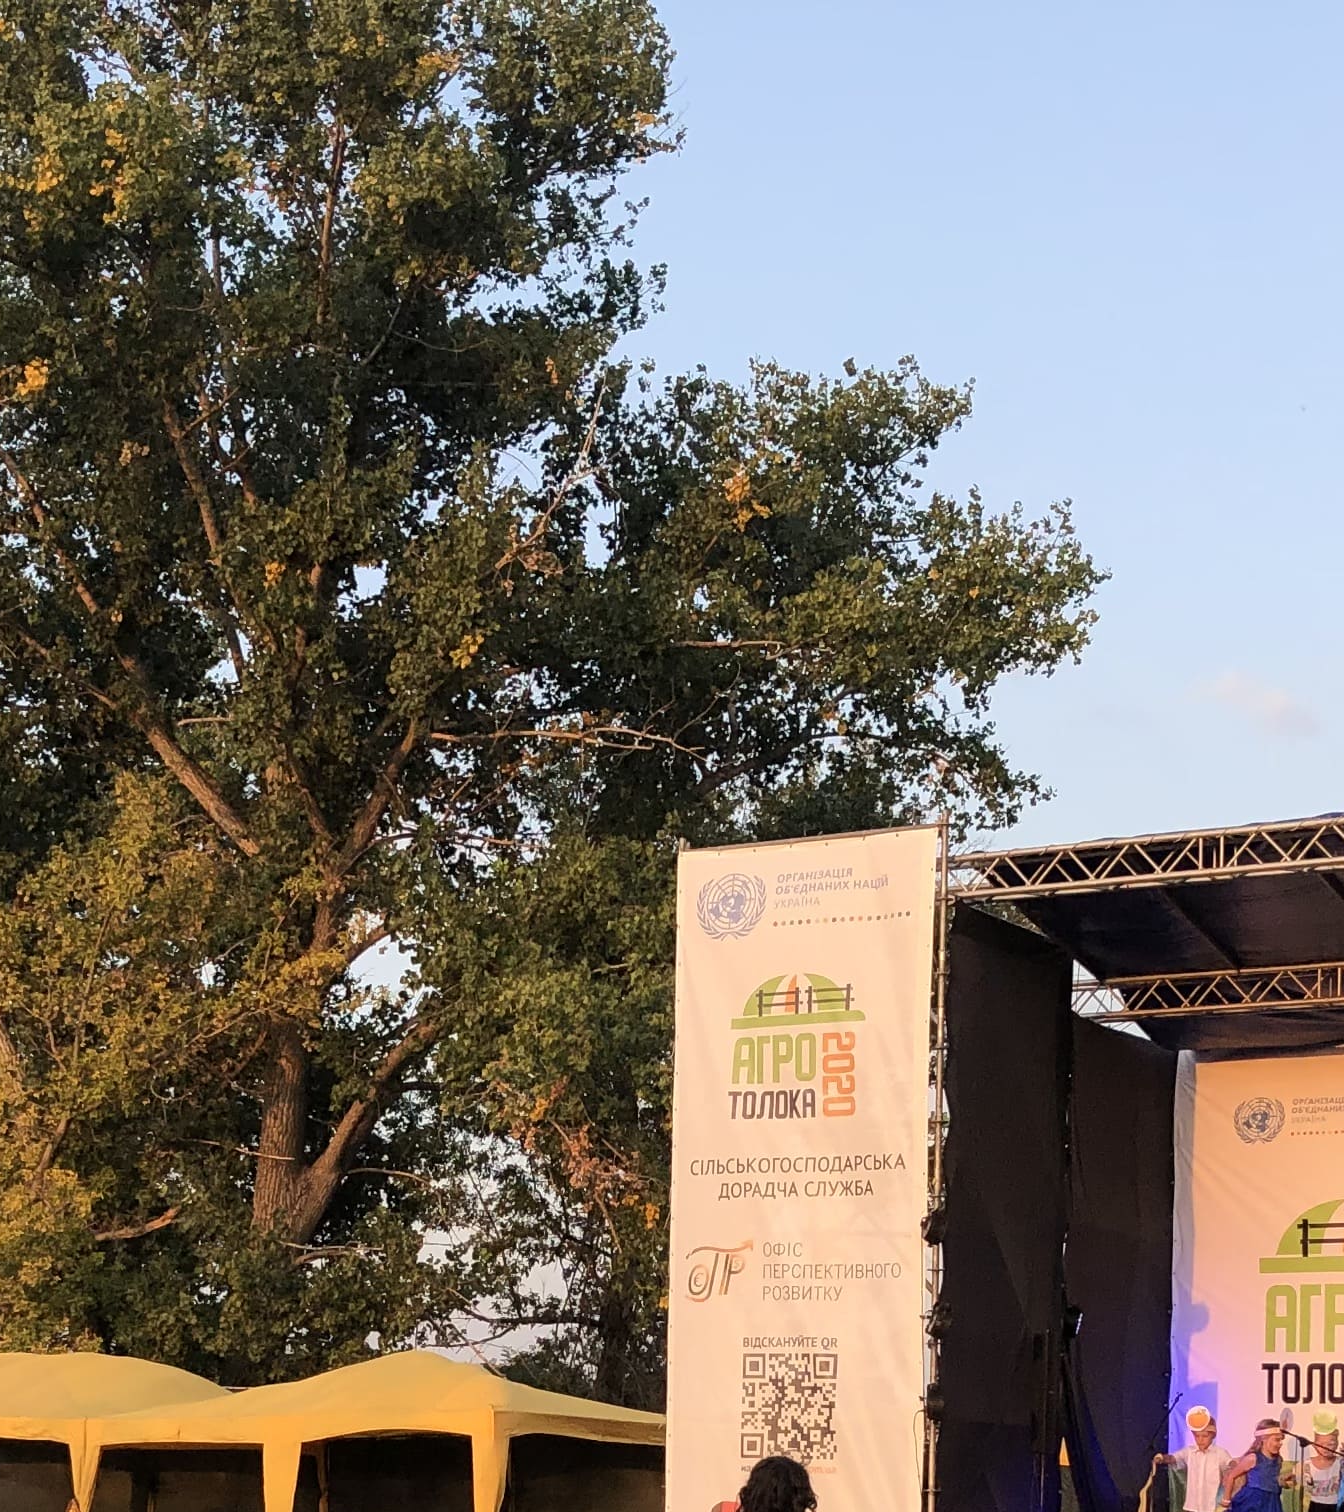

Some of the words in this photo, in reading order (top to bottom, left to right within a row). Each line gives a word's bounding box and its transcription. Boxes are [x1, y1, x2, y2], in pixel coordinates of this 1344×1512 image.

[777, 867, 853, 884] ОРГАНІЗАЦІЯ
[731, 1032, 817, 1085] АГРО
[822, 1031, 856, 1118] 2020
[727, 1088, 816, 1120] ТОЛОКА
[690, 1153, 906, 1176] СІЛЬСЬКОГОСПОДАРСЬКА
[718, 1181, 799, 1201] ДОРАДЧА
[805, 1179, 874, 1197] СЛУЖБА
[762, 1241, 803, 1258] ОФІС
[762, 1262, 902, 1280] ПЕРСПЕКТИВНОГО
[762, 1285, 843, 1301] РОЗВИТКУ
[742, 1335, 818, 1350] ВІДСКАНУЙТЕ
[821, 1336, 838, 1350] QR
